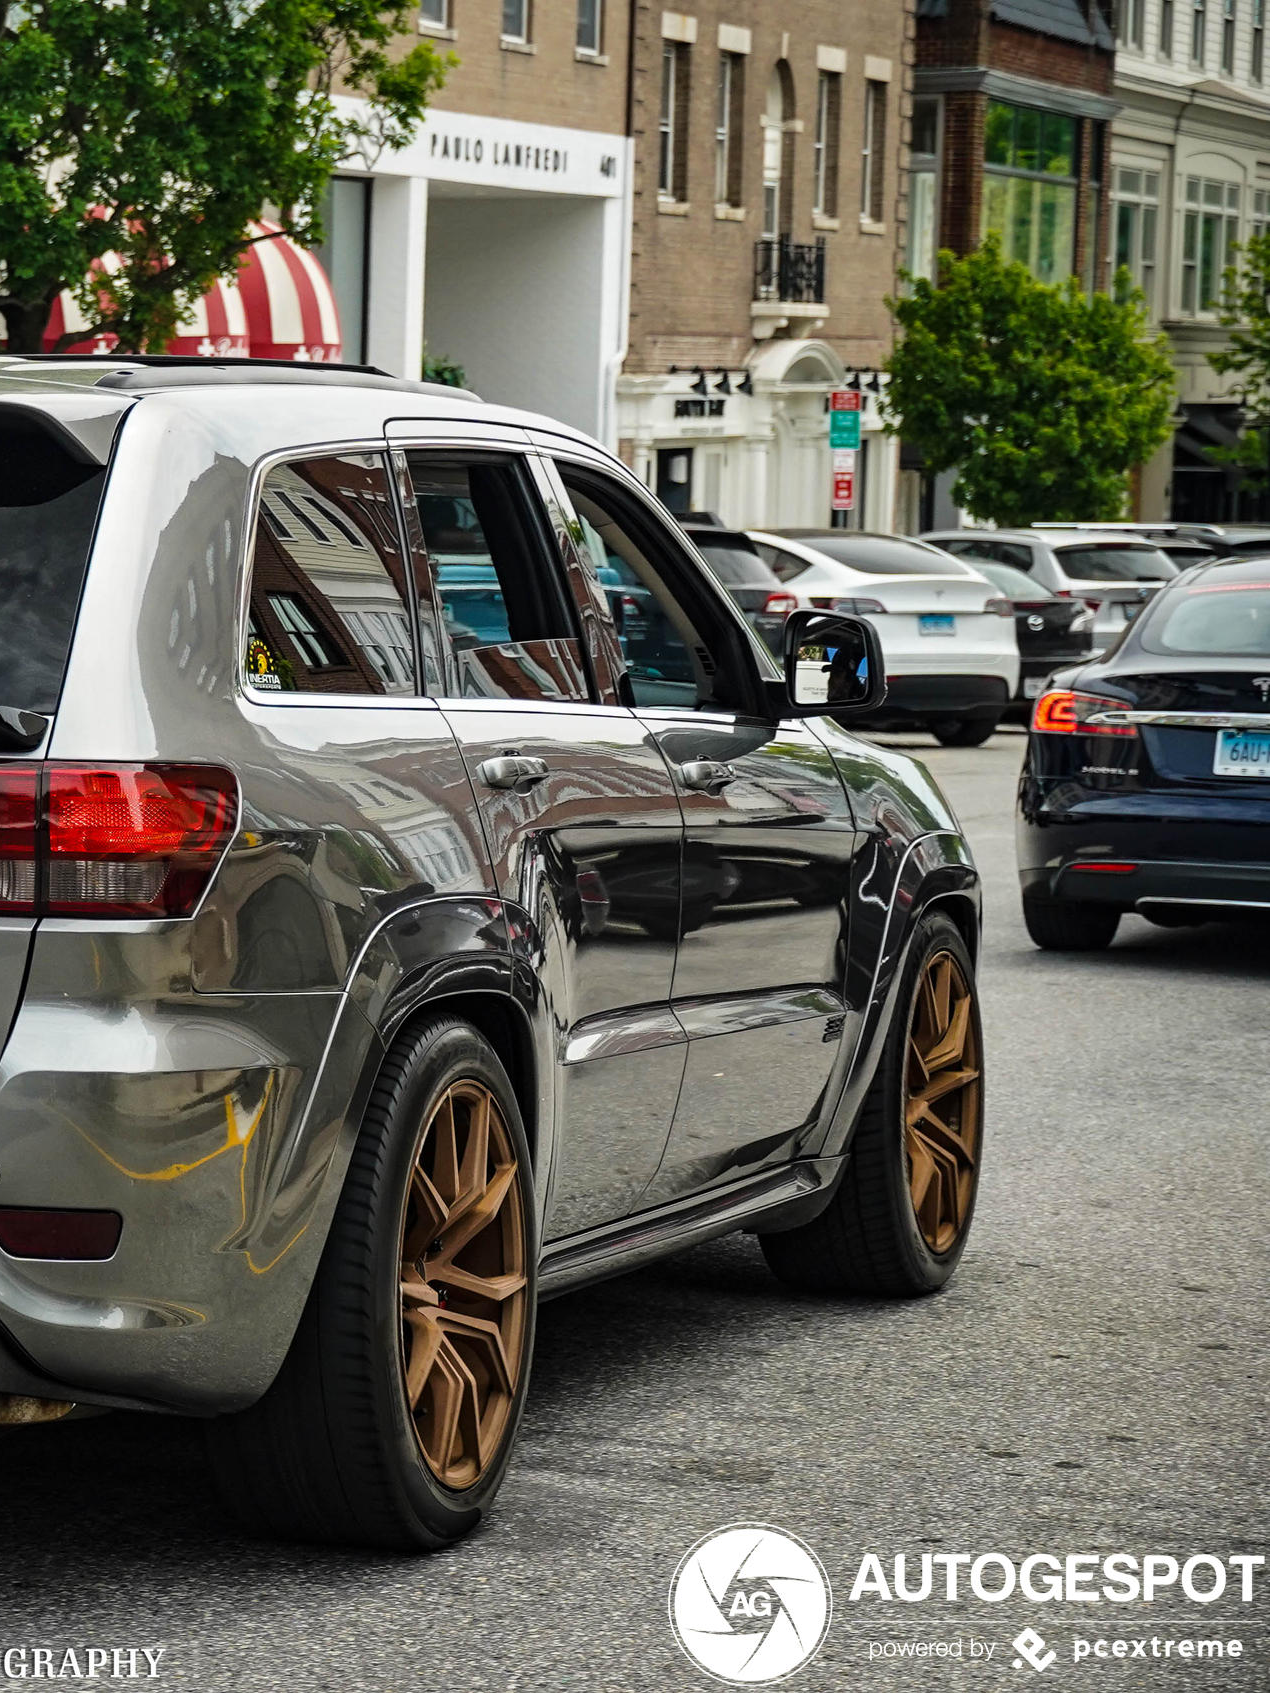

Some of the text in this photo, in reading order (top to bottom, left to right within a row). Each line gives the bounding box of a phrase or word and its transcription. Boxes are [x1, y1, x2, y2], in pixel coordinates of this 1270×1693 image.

[432, 133, 483, 163] PAULO
[493, 142, 568, 173] LANFREDI
[249, 673, 281, 684] INERTIA
